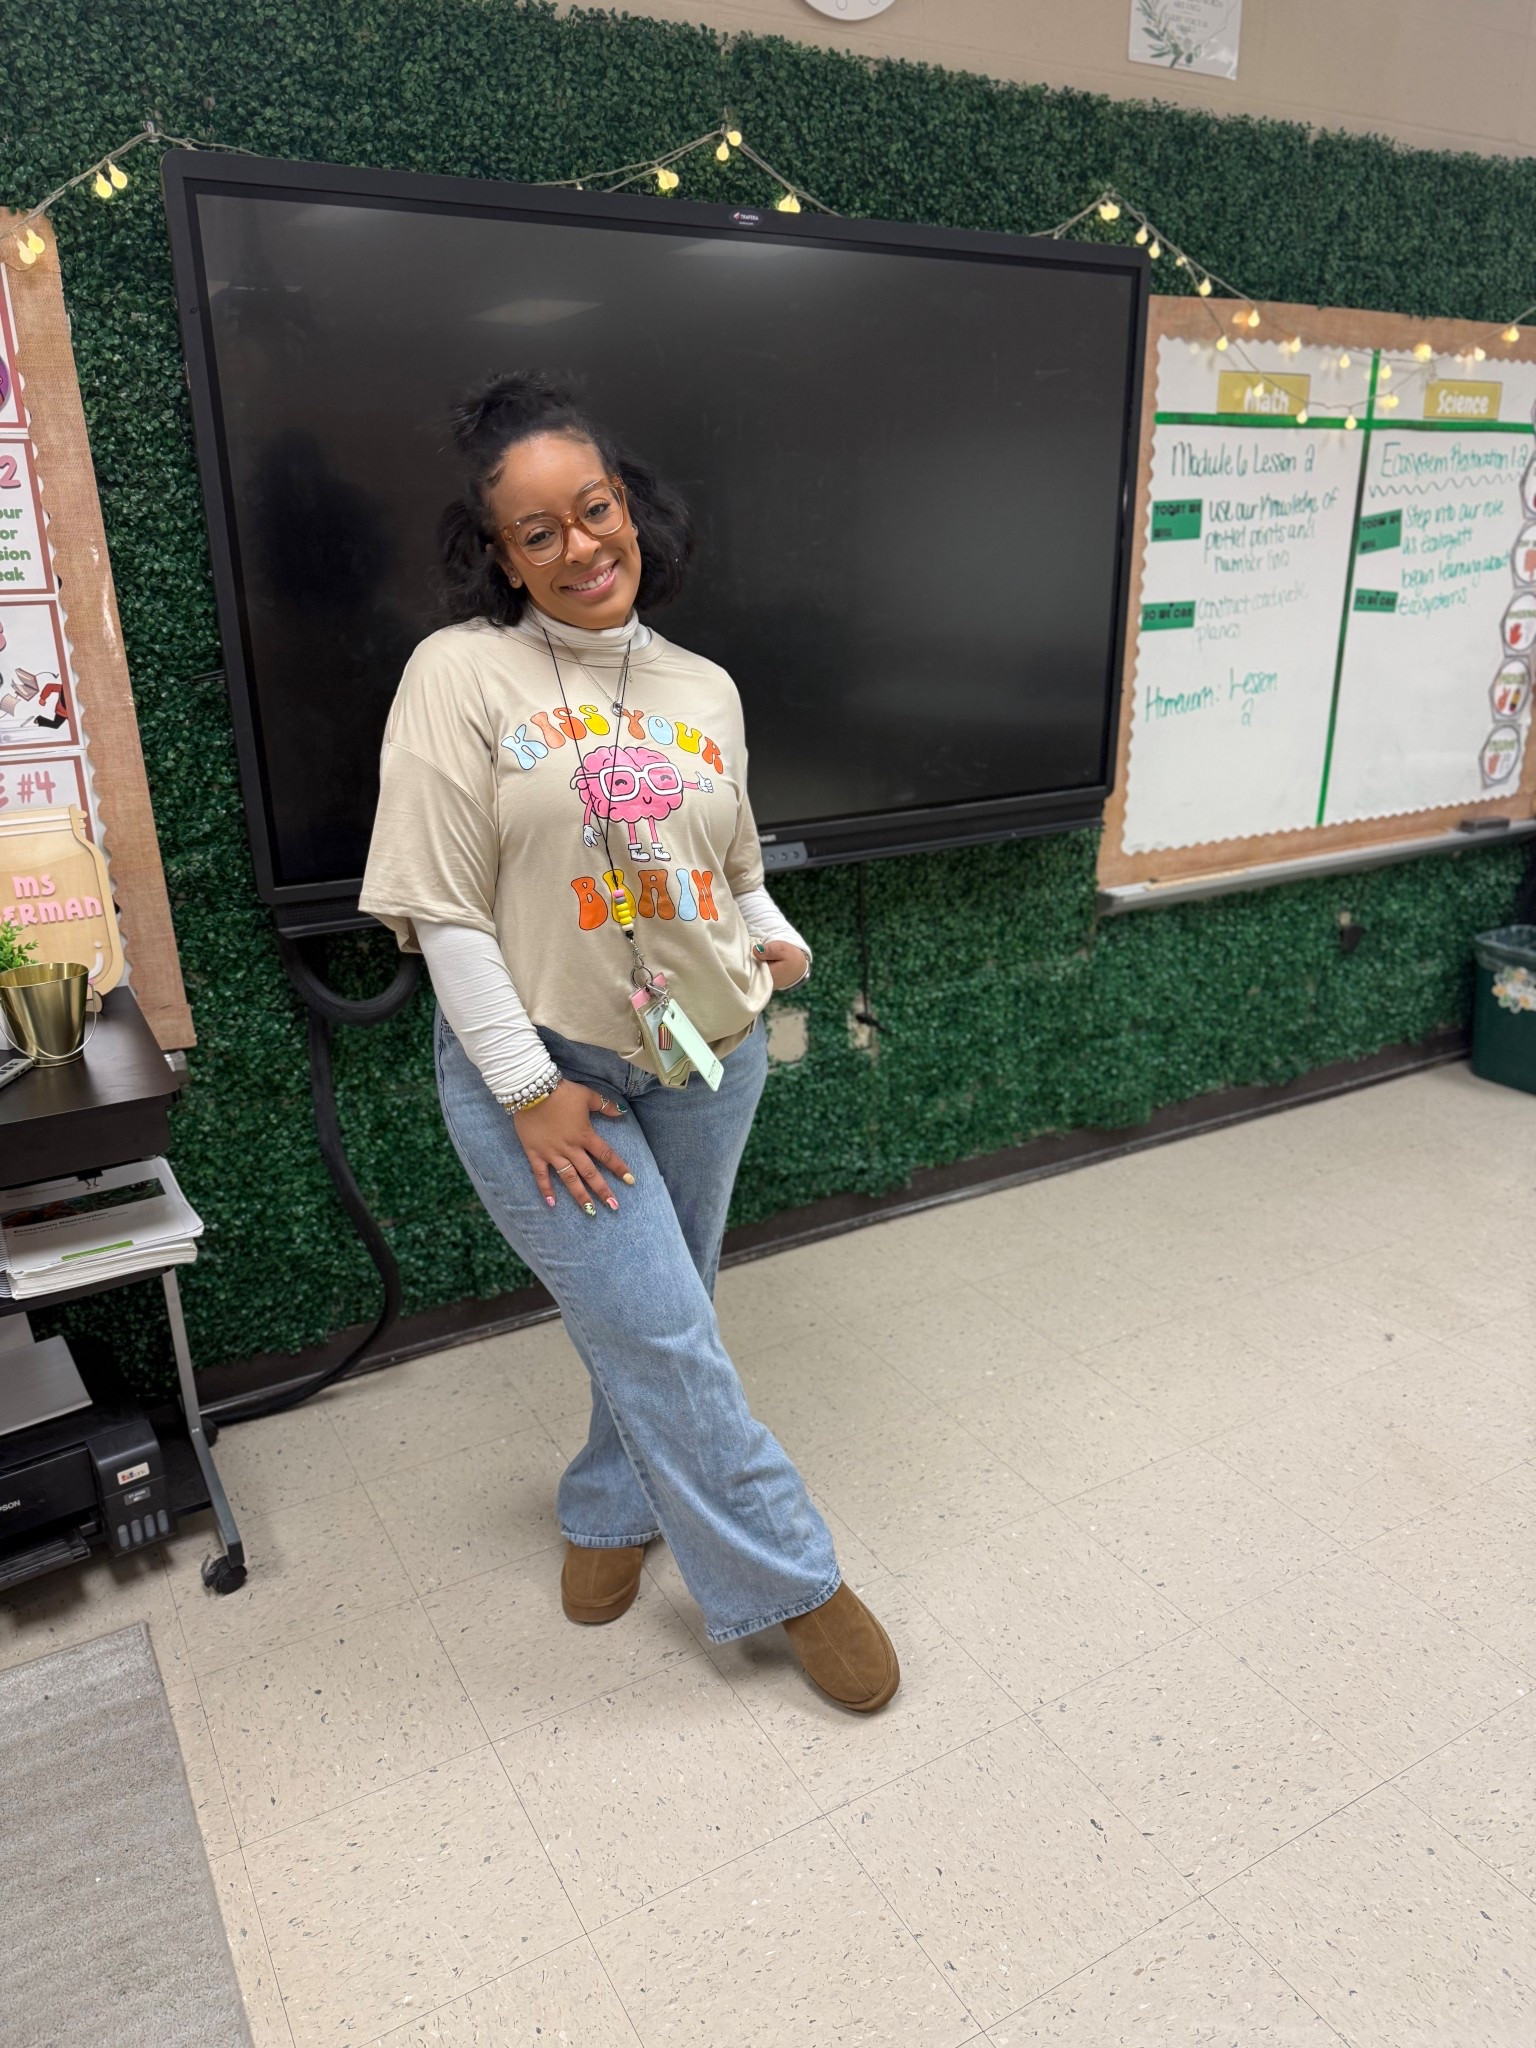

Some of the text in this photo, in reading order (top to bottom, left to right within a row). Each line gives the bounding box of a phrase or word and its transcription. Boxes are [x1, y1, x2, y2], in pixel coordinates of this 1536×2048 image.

[1243, 385, 1289, 414] Math
[1437, 388, 1489, 415] Science
[1171, 441, 1315, 477] Module 6 Lesson 2
[1229, 667, 1277, 700] Lesson
[501, 704, 724, 774] KISS YOUR
[17, 770, 56, 804] #4
[12, 874, 56, 898] MS
[571, 868, 719, 931] BRAIN
[0, 895, 103, 929] ERMAN
